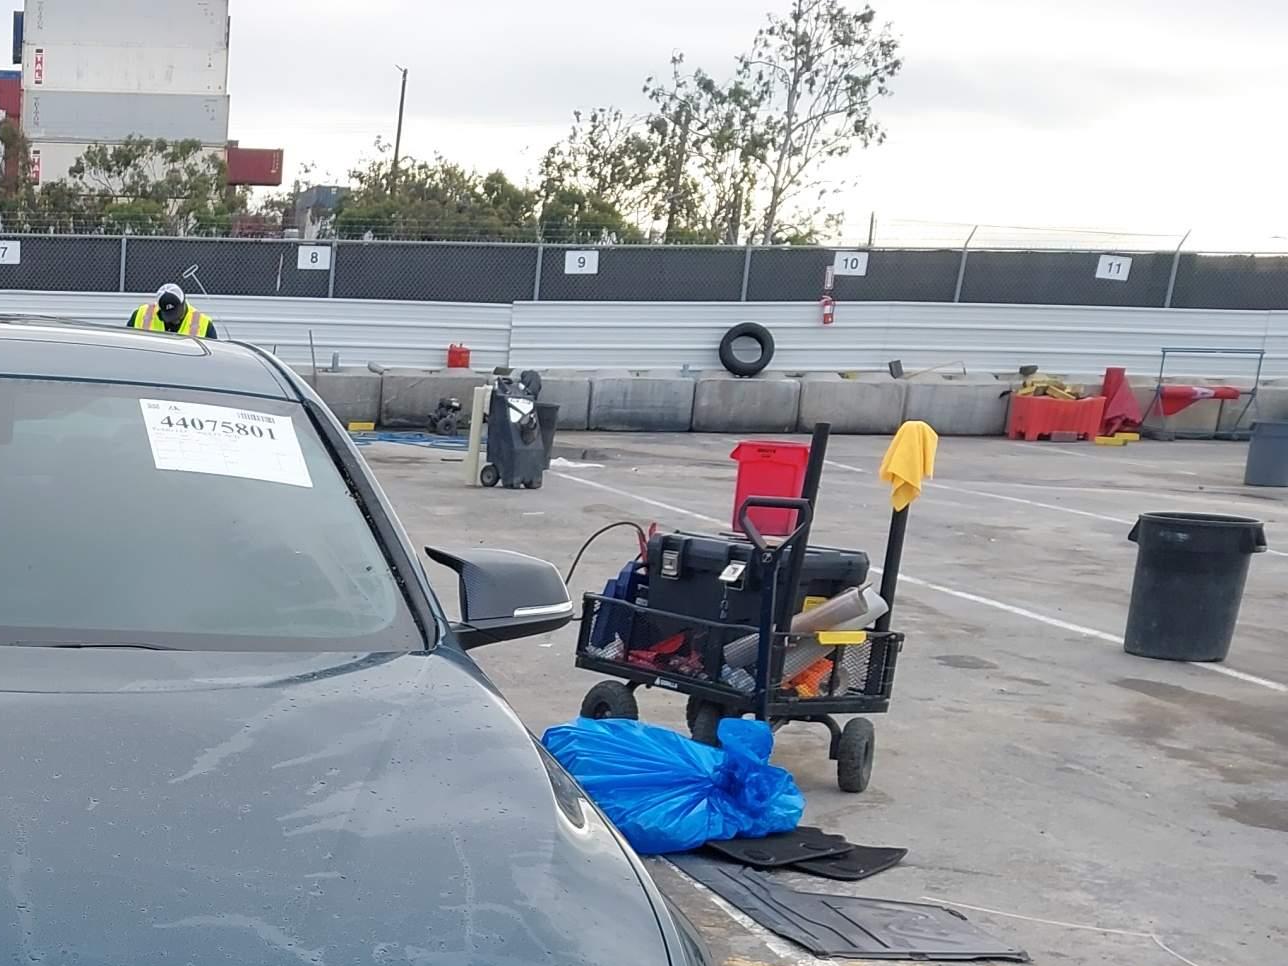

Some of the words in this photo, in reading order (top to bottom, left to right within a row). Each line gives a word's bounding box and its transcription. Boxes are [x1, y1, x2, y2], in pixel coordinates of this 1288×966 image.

[0, 246, 8, 258] 7
[310, 251, 319, 264] 8
[577, 256, 586, 268] 9
[843, 257, 859, 270] 10
[1107, 261, 1122, 275] 11
[160, 415, 277, 441] 44075801
